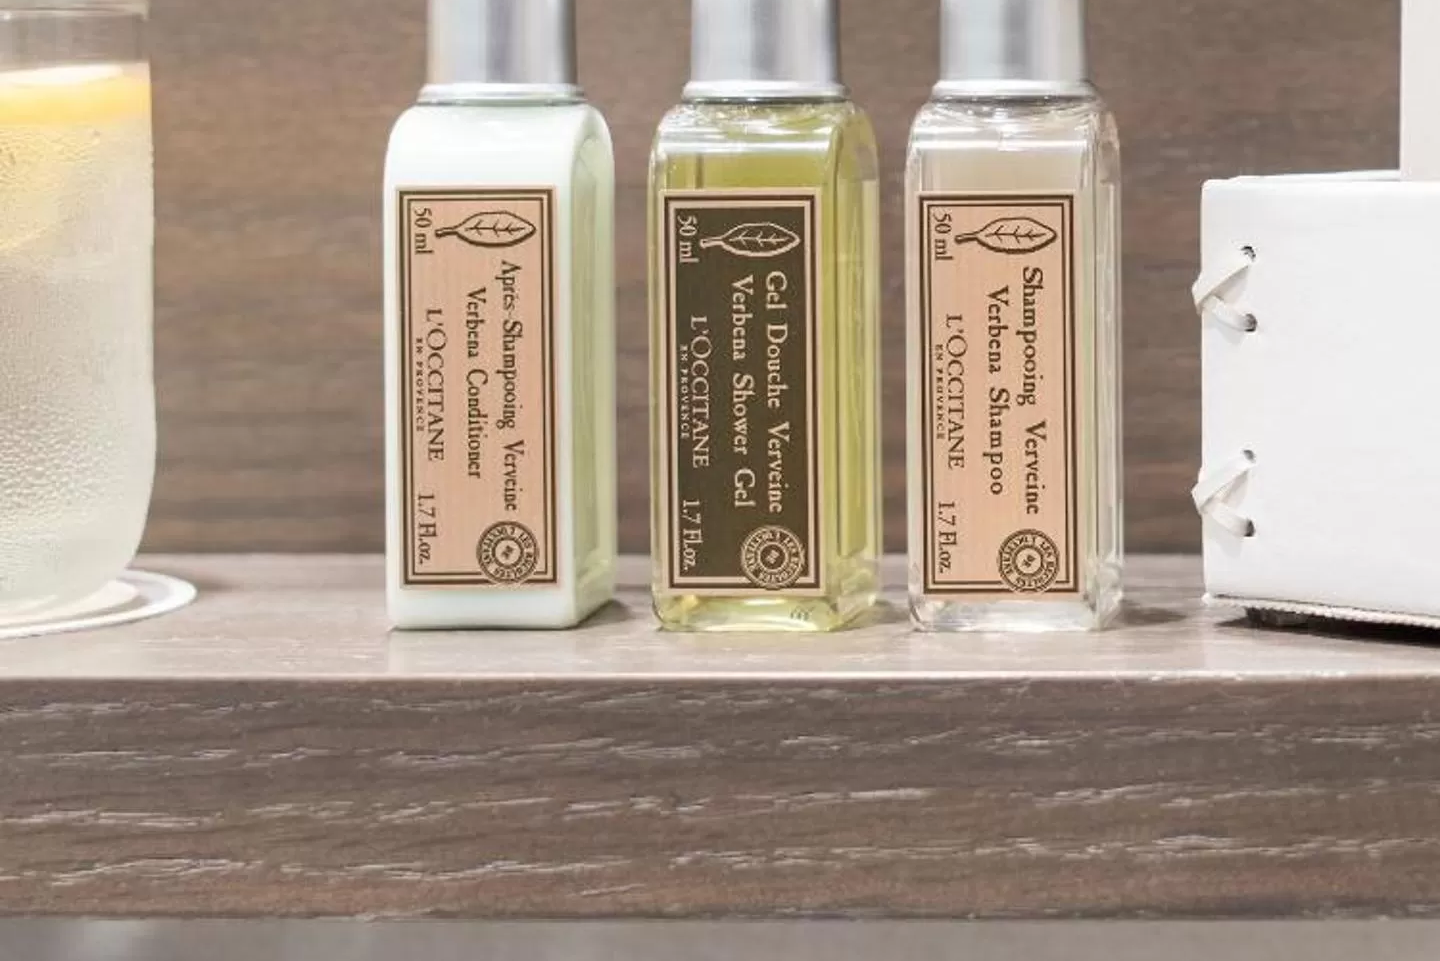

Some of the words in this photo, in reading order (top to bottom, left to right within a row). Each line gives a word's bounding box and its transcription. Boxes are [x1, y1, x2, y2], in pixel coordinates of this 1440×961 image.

[414, 207, 433, 229] 50
[414, 232, 435, 255] ml
[677, 215, 698, 237] 50
[679, 240, 699, 263] ml
[932, 213, 953, 235] 50
[934, 238, 954, 261] ml
[465, 286, 487, 359] Verbena
[731, 274, 754, 361] Verbena
[765, 270, 788, 310] Gel
[767, 323, 789, 408] Douche
[987, 284, 1010, 375] Verbena
[1015, 266, 1044, 407] Shampooing
[426, 308, 447, 461] L'OCCITANE
[690, 316, 712, 468] L'OCCITANE
[732, 372, 756, 455] Shower
[945, 313, 967, 470] L'OCCITANE
[465, 368, 489, 479] Conditioner
[982, 386, 1011, 496] Shampoo
[503, 439, 525, 511] Verveine
[734, 467, 756, 507] Gel
[767, 421, 790, 513] Verveine
[1024, 420, 1047, 515] Verveine
[417, 494, 436, 518] 1.7
[682, 499, 702, 524] 1.7
[937, 501, 957, 527] 1.7
